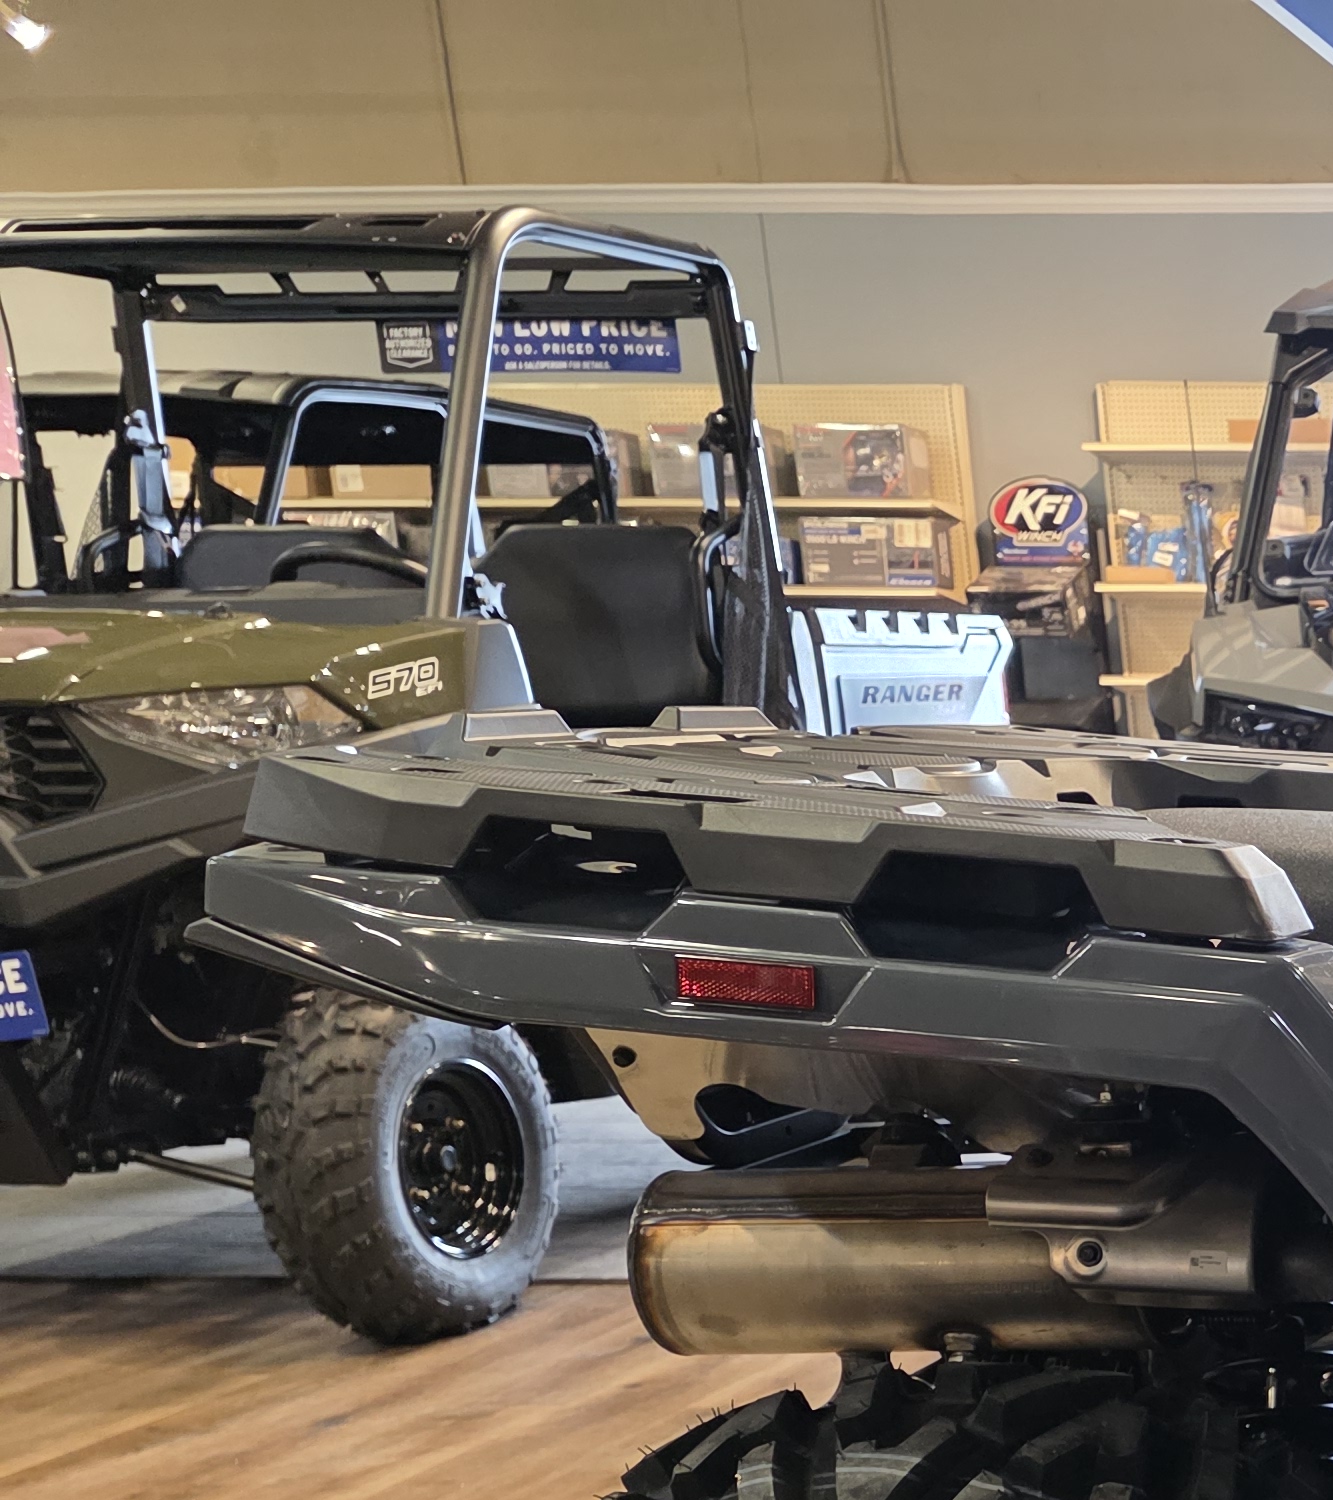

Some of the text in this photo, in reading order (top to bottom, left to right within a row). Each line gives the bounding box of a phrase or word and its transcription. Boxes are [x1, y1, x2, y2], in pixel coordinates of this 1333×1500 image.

[513, 318, 571, 337] LOW
[580, 318, 668, 338] PRICE
[542, 342, 594, 356] PRICED
[599, 342, 619, 355] TO
[624, 343, 671, 357] MOVE.
[1017, 530, 1063, 543] WINCH
[367, 656, 439, 699] 570
[860, 683, 963, 705] RANGER
